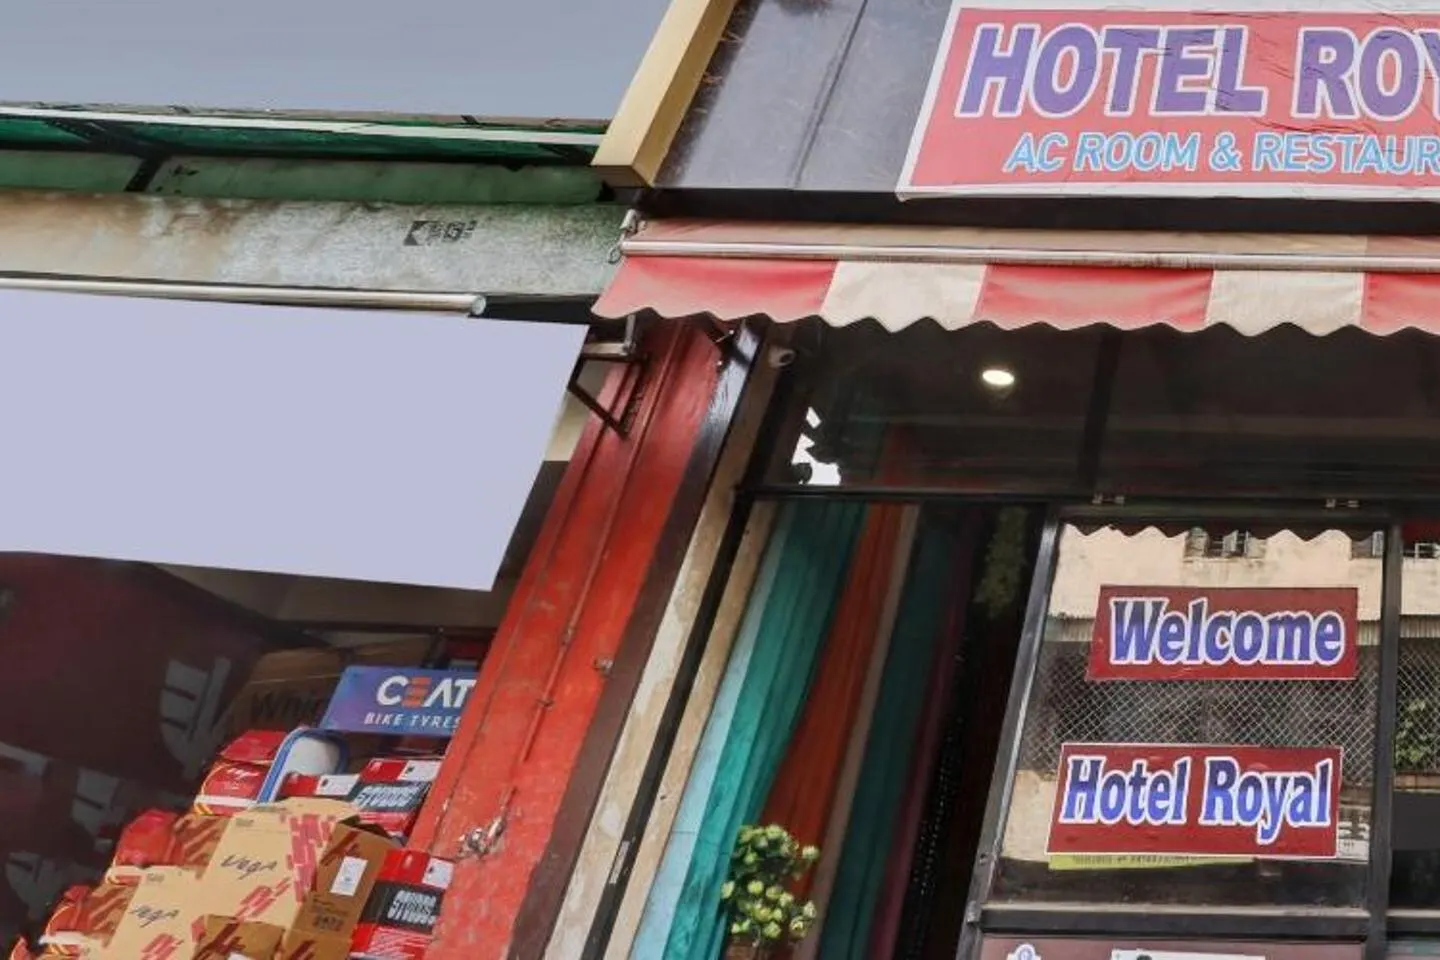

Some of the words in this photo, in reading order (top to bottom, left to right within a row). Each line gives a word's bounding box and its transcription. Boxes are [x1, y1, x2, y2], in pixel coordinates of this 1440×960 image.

[955, 22, 1269, 119] HOTEL
[1003, 131, 1067, 173] AC
[1072, 131, 1200, 173] ROOM
[1209, 132, 1241, 172] &
[1110, 597, 1345, 666] Welcome
[376, 675, 477, 708] CEAT
[364, 711, 402, 726] BIKE
[411, 713, 462, 730] TYRES
[1059, 754, 1192, 825] Hotel
[1199, 756, 1333, 846] Royal
